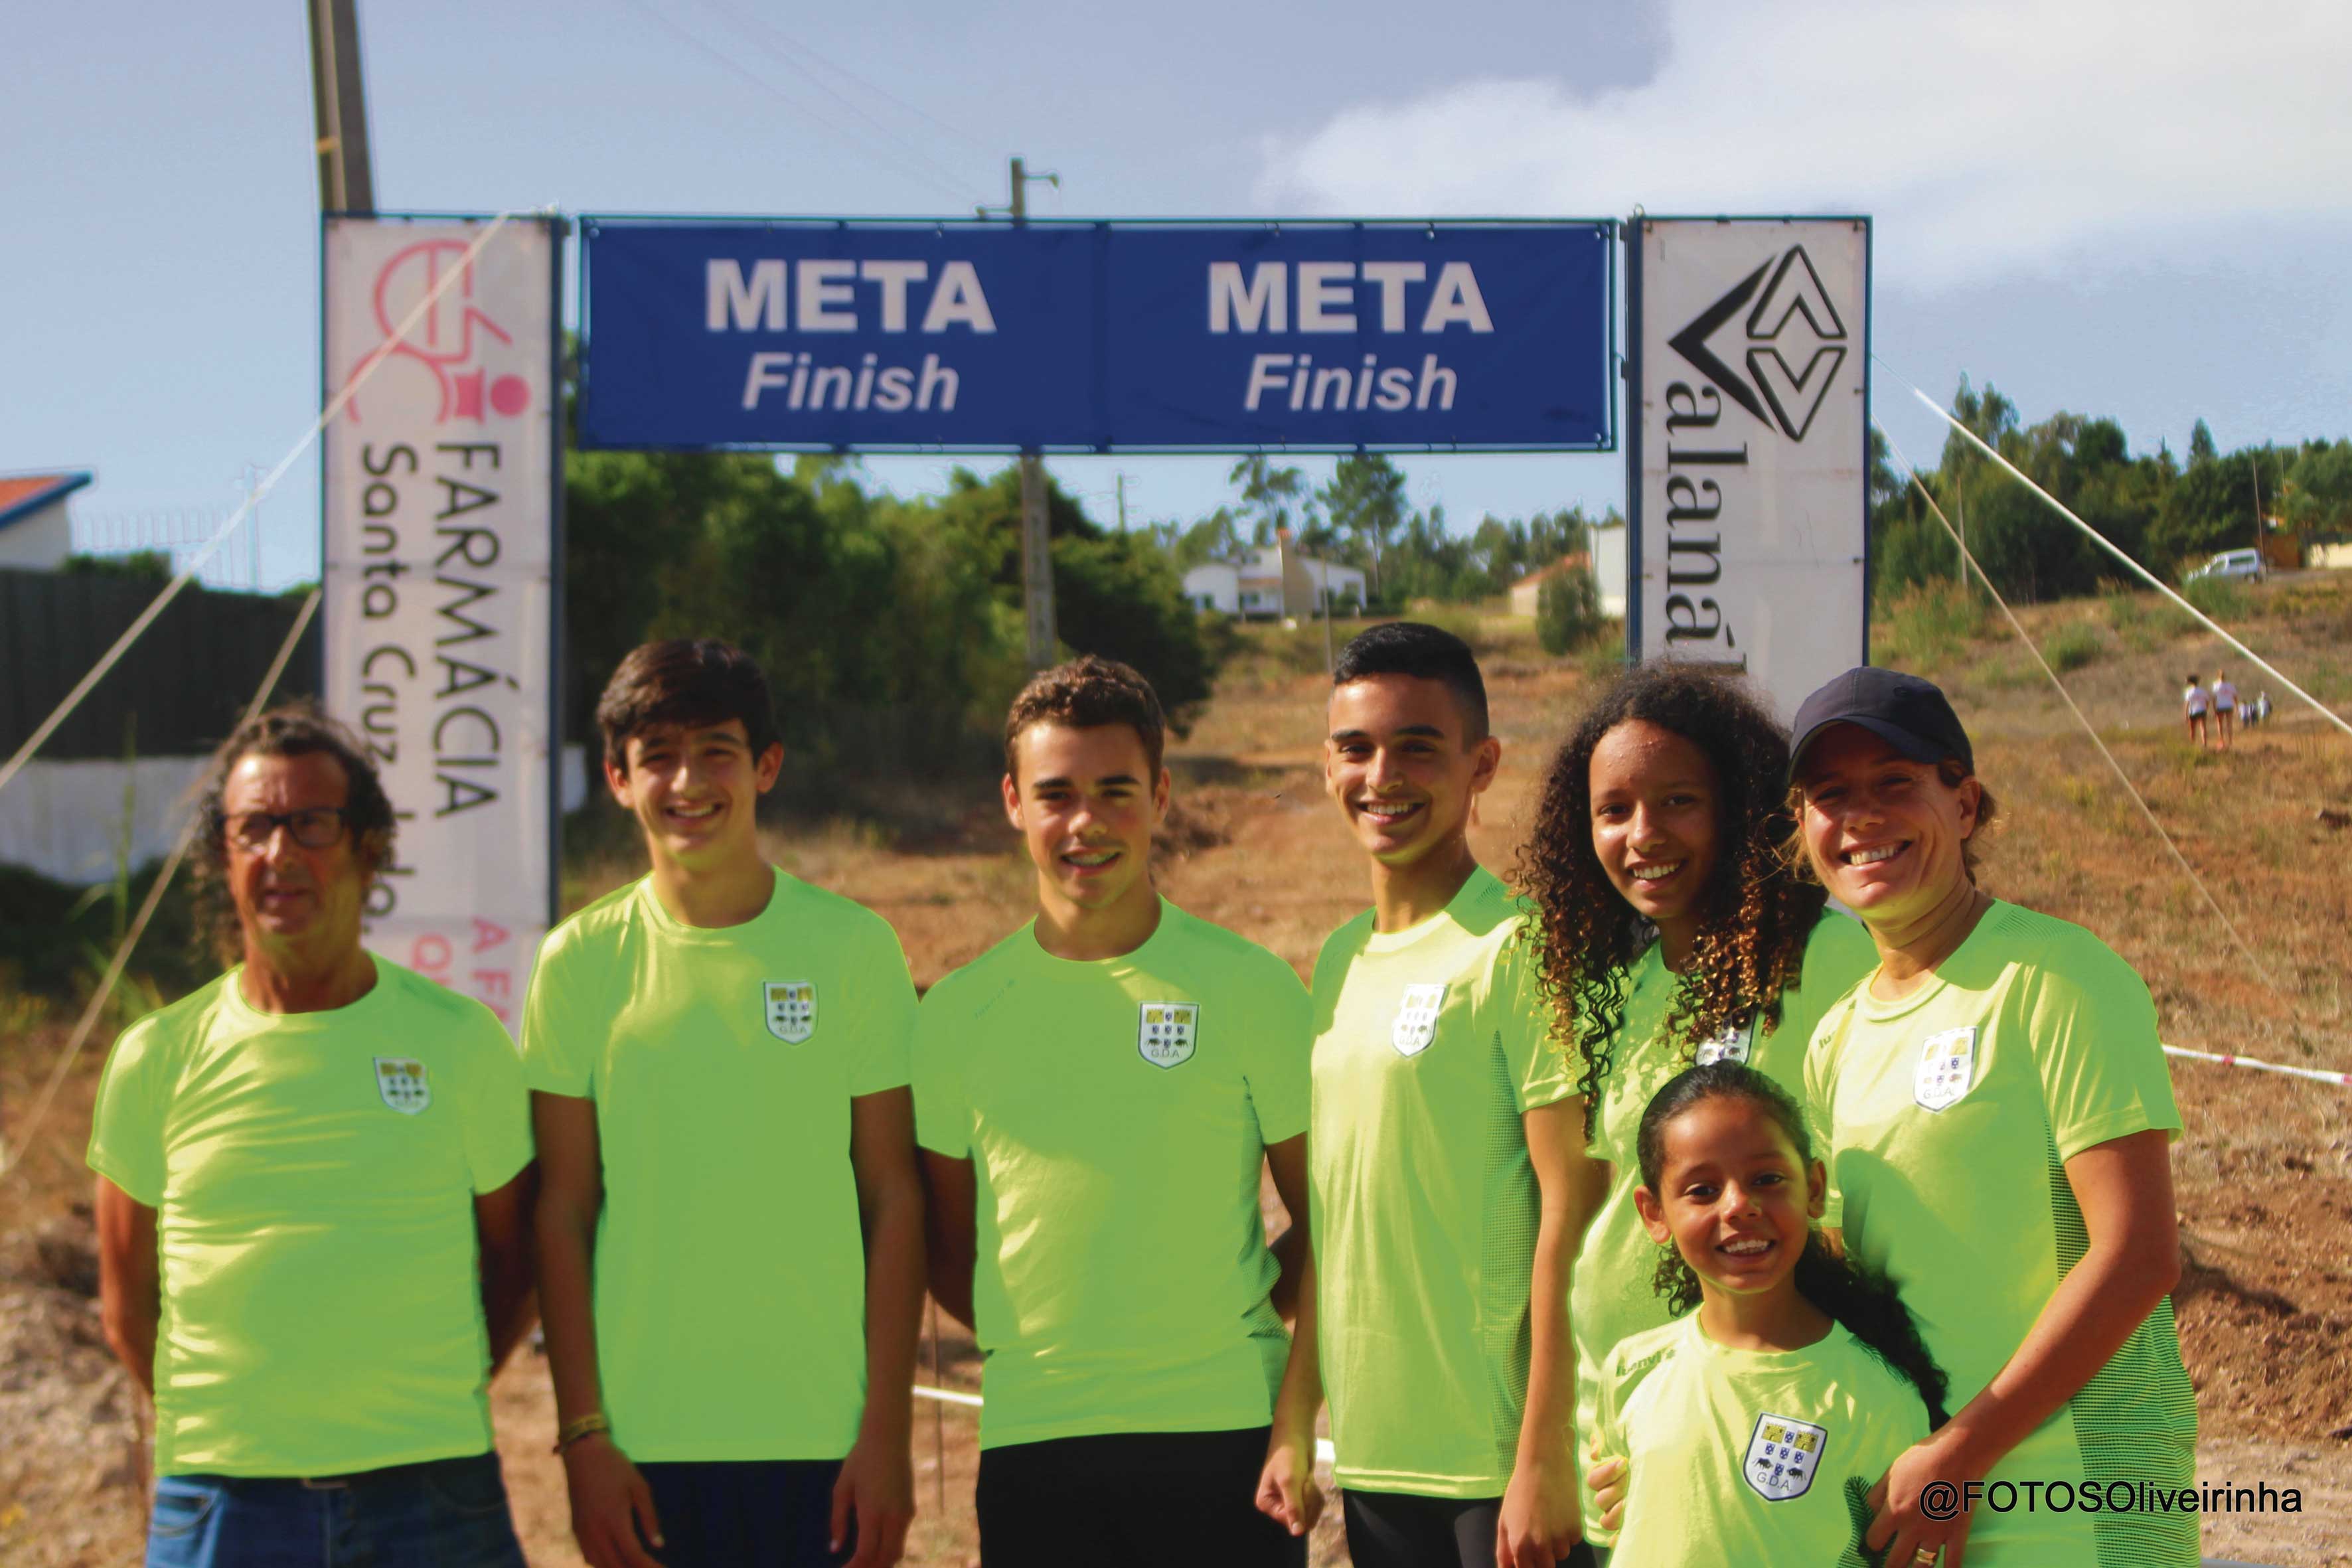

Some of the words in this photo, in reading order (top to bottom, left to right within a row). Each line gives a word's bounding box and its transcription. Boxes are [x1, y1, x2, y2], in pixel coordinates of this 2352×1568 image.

[706, 258, 997, 332] META
[1208, 262, 1495, 333] META
[742, 352, 960, 412] Finish
[1243, 353, 1458, 412] Finish
[361, 443, 418, 619] Santa
[433, 443, 520, 818] FARMÁCIA
[361, 645, 416, 763] Cruz
[471, 914, 510, 955] A
[1756, 1471, 1792, 1492] G.D.A.
